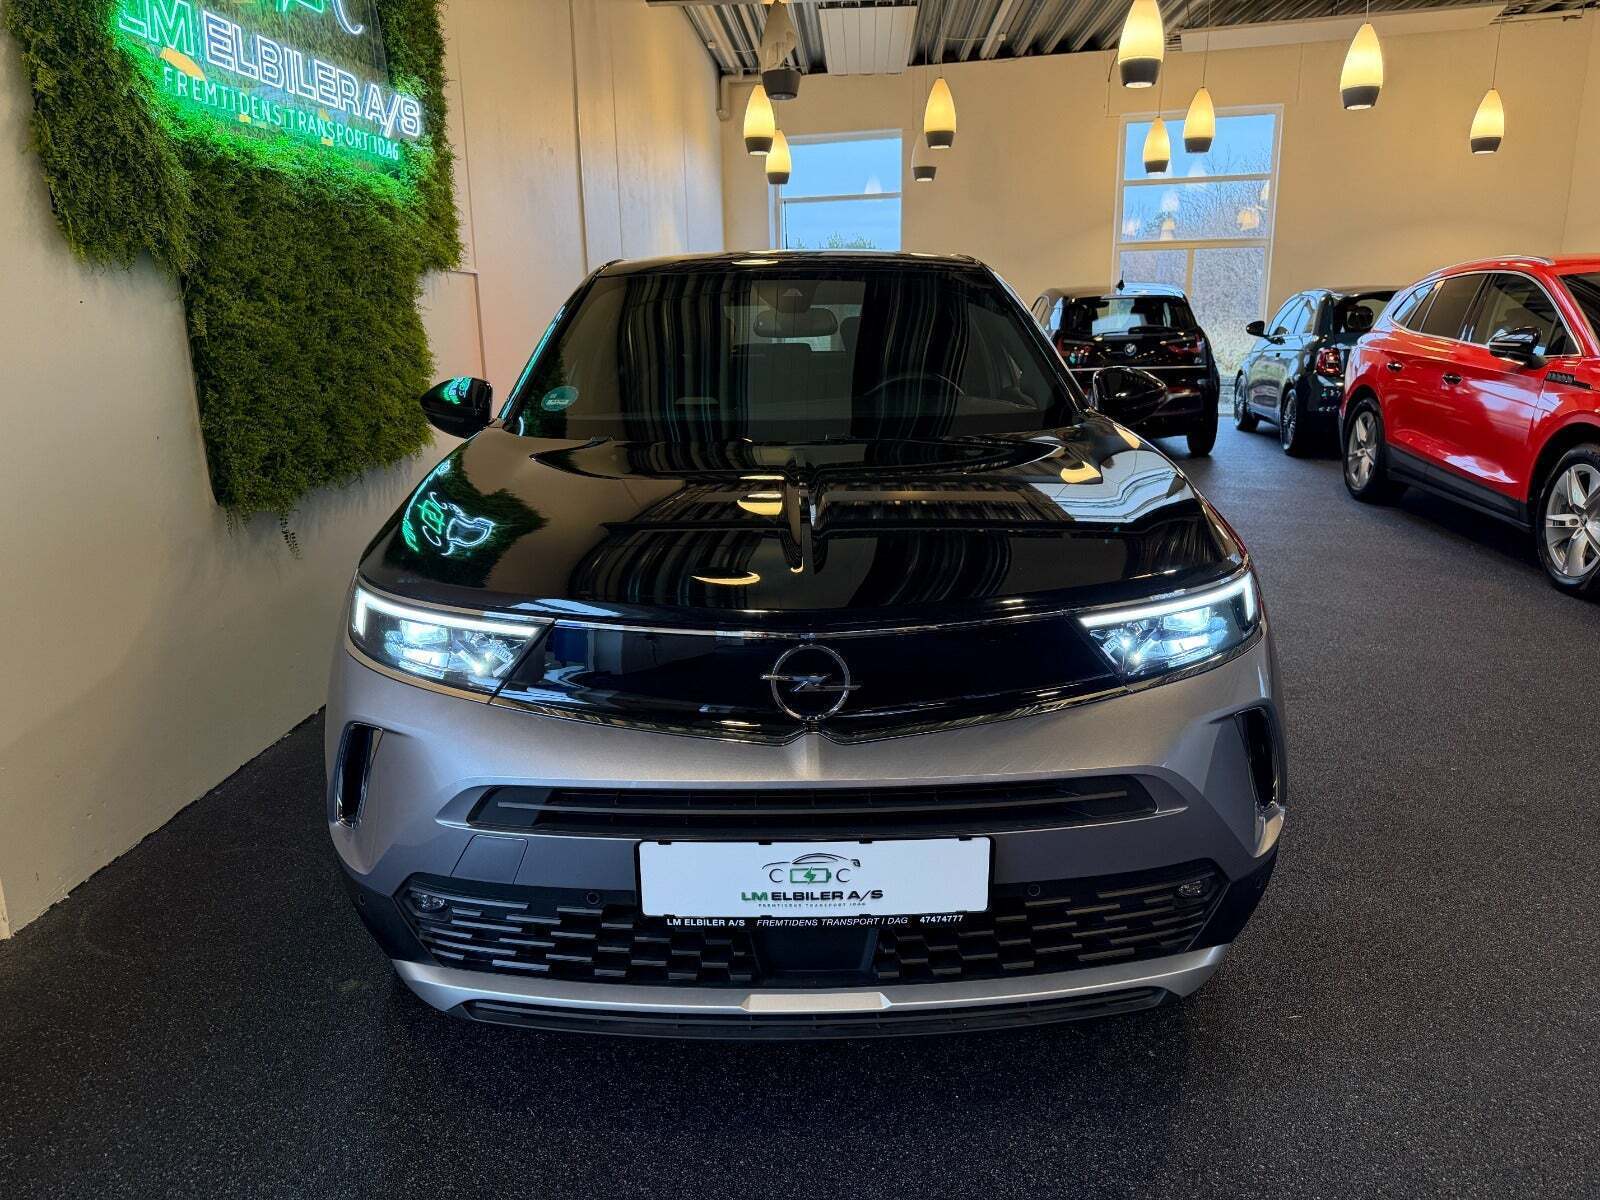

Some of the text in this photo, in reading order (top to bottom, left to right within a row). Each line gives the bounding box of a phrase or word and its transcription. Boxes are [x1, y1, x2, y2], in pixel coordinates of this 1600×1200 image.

[202, 10, 361, 117] ELBILER
[364, 82, 421, 139] A/S
[163, 66, 283, 127] FREMTIDENS
[284, 108, 369, 151] TRANSPORT
[741, 889, 884, 902] LM ELBILER A/S
[666, 918, 682, 926] LM
[684, 918, 726, 927] ELBILER
[728, 919, 746, 927] A/S
[756, 918, 818, 927] FREMTIDENS
[821, 917, 880, 926] TRANSPORT
[887, 916, 908, 925] DAG
[919, 914, 964, 924] 47474777
